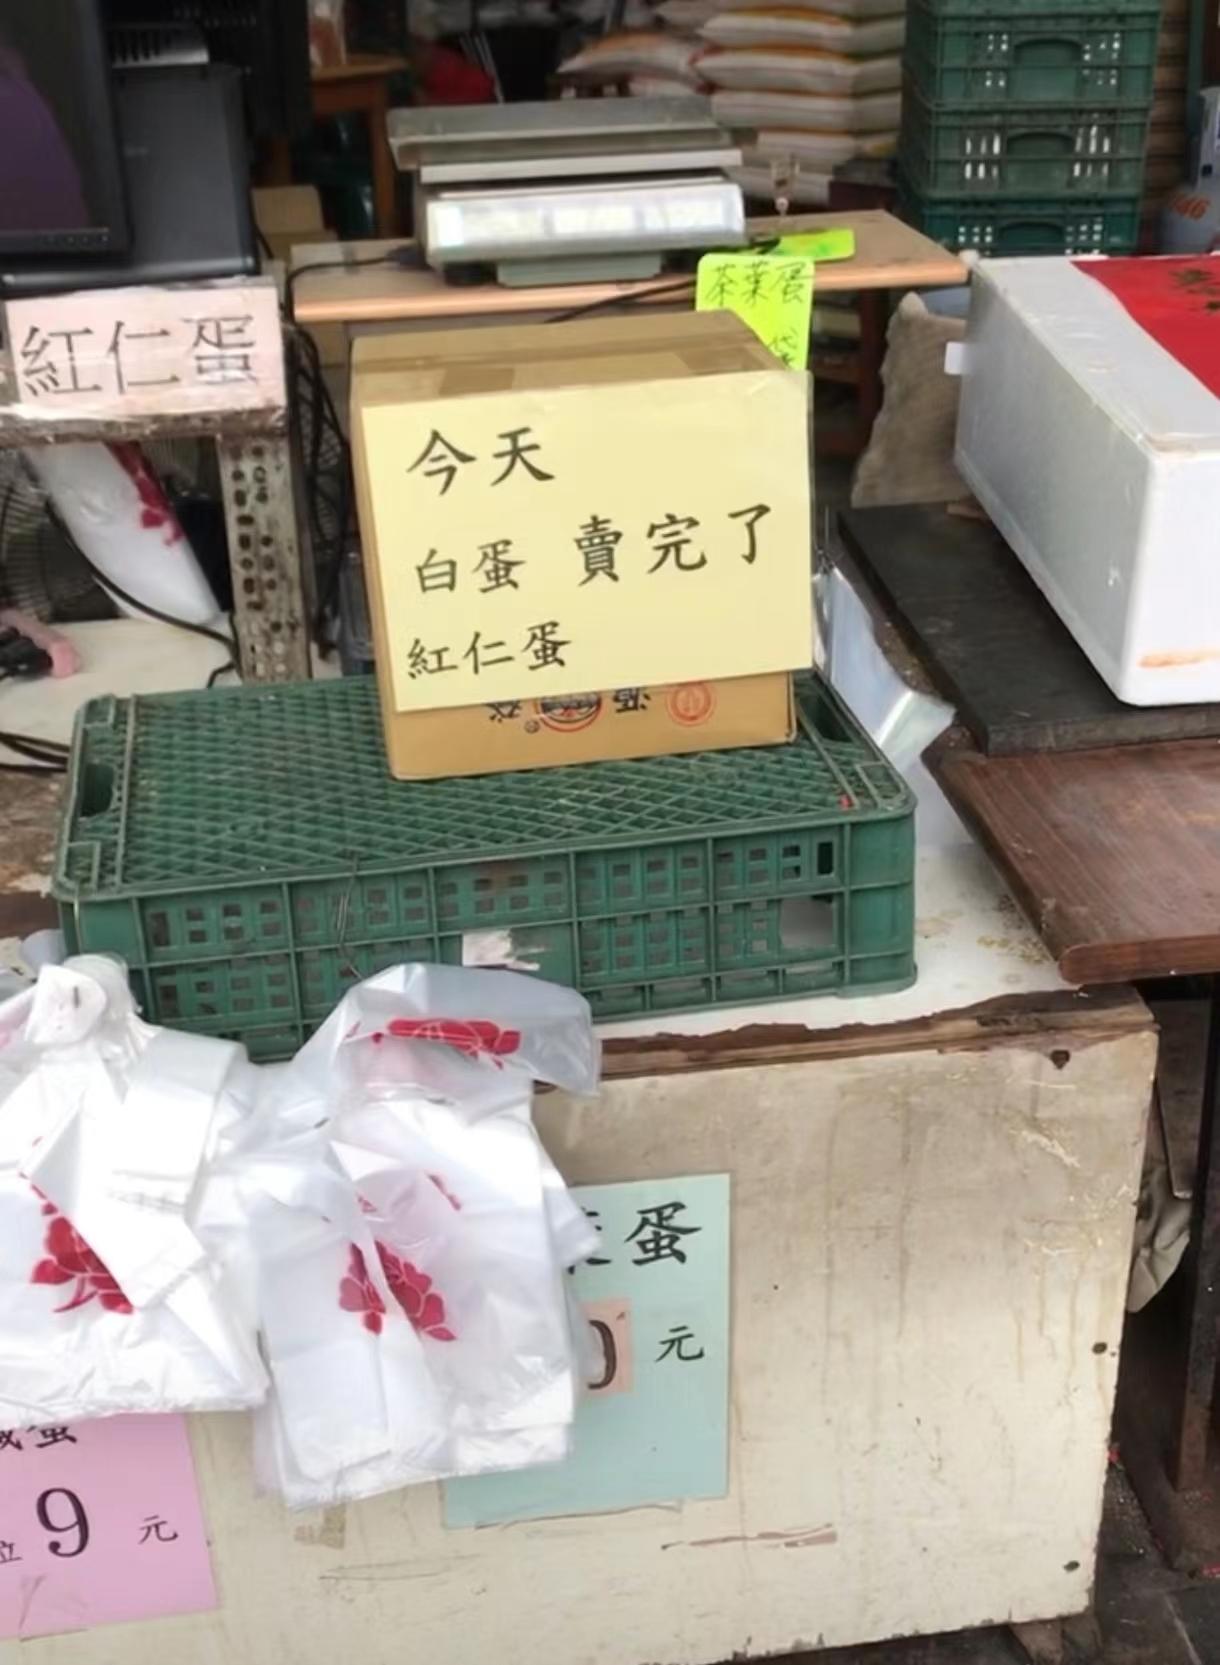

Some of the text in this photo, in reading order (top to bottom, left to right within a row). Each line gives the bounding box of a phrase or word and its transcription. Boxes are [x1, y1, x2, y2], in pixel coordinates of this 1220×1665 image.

[20, 315, 257, 396] 紅仁蛋
[406, 427, 556, 496] 今天
[415, 503, 771, 594] 白蛋 賣完了
[407, 621, 571, 679] 紅仁蛋
[655, 1325, 704, 1363] 元
[36, 1487, 90, 1558] 9
[137, 1514, 179, 1545] 元
